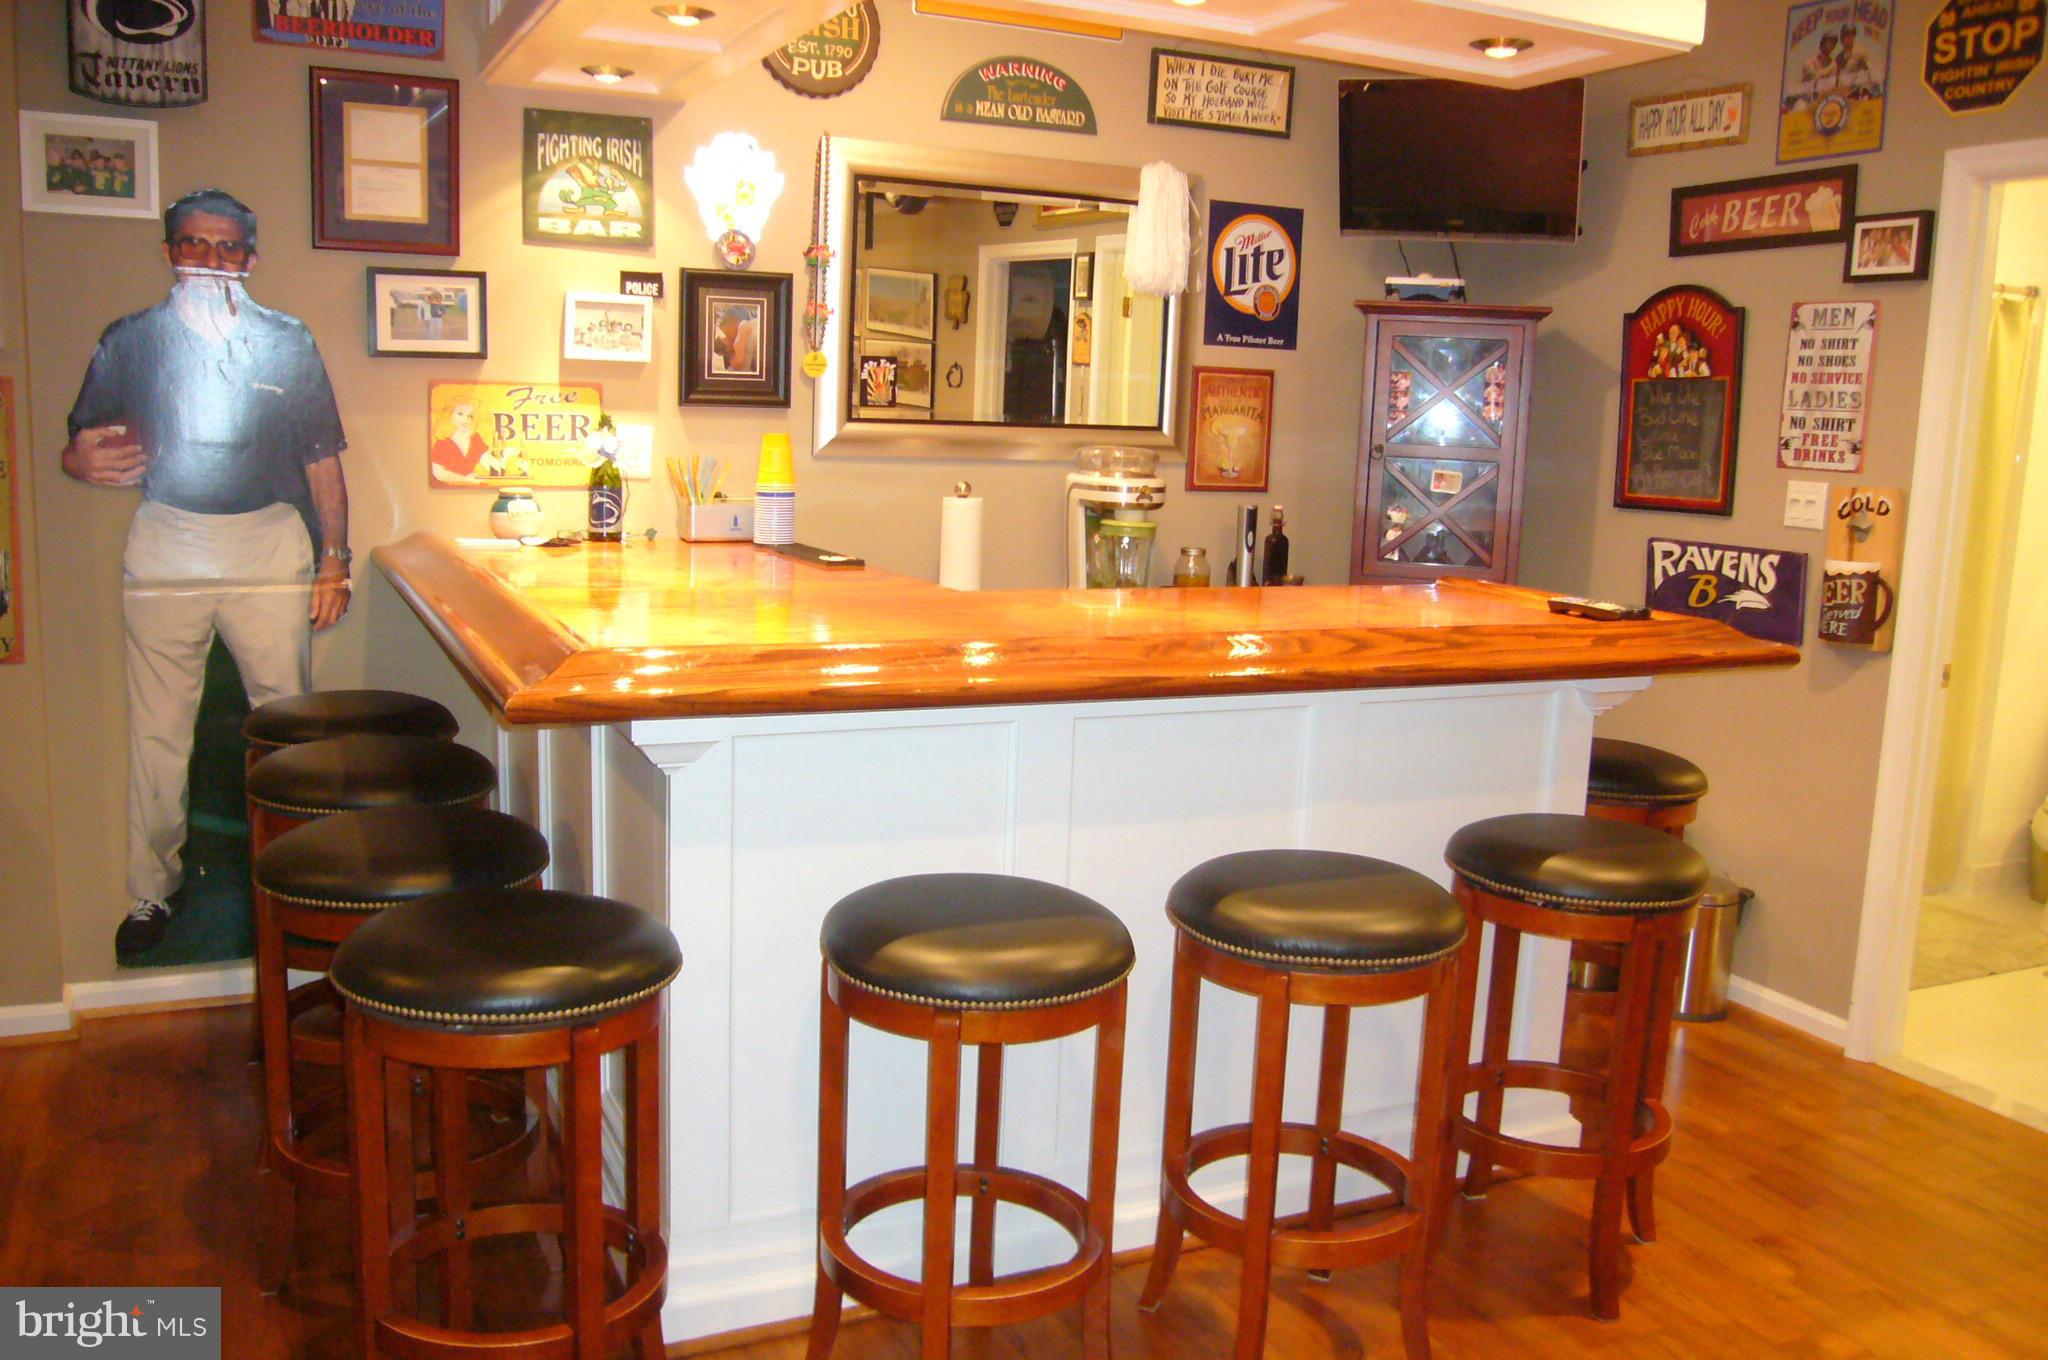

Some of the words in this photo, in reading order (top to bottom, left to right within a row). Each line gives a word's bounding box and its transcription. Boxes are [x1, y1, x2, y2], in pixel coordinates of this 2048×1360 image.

[275, 15, 434, 46] BEERHOLDER
[1934, 16, 2040, 64] STOP
[824, 44, 853, 59] 1790
[77, 51, 200, 95] Tavern
[106, 56, 161, 71] NITTANY
[165, 61, 199, 75] LIONS
[792, 57, 843, 80] PUB
[1166, 58, 1196, 76] WHEN
[1201, 62, 1205, 76] I
[1233, 68, 1256, 85] BURY
[1259, 73, 1275, 86] ME
[978, 62, 1068, 92] WARNING
[1163, 78, 1178, 90] ON
[1165, 91, 1177, 104] SO
[1184, 93, 1196, 107] MY
[1944, 78, 2016, 100] COUNTRY
[976, 100, 1005, 119] MEAN
[1008, 105, 1033, 121] OLD
[1036, 107, 1085, 127] BASTARD
[1190, 108, 1203, 120] ME
[1639, 107, 1664, 140] HAPPY
[1665, 104, 1687, 136] HOUR
[1690, 103, 1705, 132] ALL
[1708, 99, 1725, 131] DAY
[537, 133, 602, 171] FIGHTING
[607, 138, 643, 178] IRISH
[1722, 192, 1802, 233] BEER
[538, 217, 642, 238] BAR
[1234, 230, 1272, 251] Miller
[1223, 243, 1285, 296] Lite
[625, 281, 659, 296] POLICE
[1640, 296, 1685, 338] HAPPY
[1811, 307, 1856, 327] MEN
[1217, 333, 1223, 341] A
[1225, 334, 1241, 343] True
[1268, 337, 1284, 346] Beer
[1800, 338, 1815, 350] NO
[1820, 338, 1859, 350] SHIRT
[1797, 355, 1813, 367] NO
[1818, 355, 1856, 367] SHOES
[1791, 372, 1807, 384] NO
[1810, 372, 1863, 385] SERVICE
[506, 387, 577, 410] Free
[1788, 389, 1862, 409] LADIES
[493, 413, 591, 441] BEER
[1789, 416, 1806, 430] NO
[1812, 417, 1856, 432] SHIRT
[1801, 433, 1839, 448] FREE
[530, 458, 585, 467] TOMORR
[1793, 448, 1846, 464] DRINKS
[1837, 495, 1891, 520] COLD
[1651, 541, 1781, 594] RAVENS
[1688, 574, 1718, 608] B
[1823, 578, 1868, 606] EER
[1822, 620, 1848, 636] ERE
